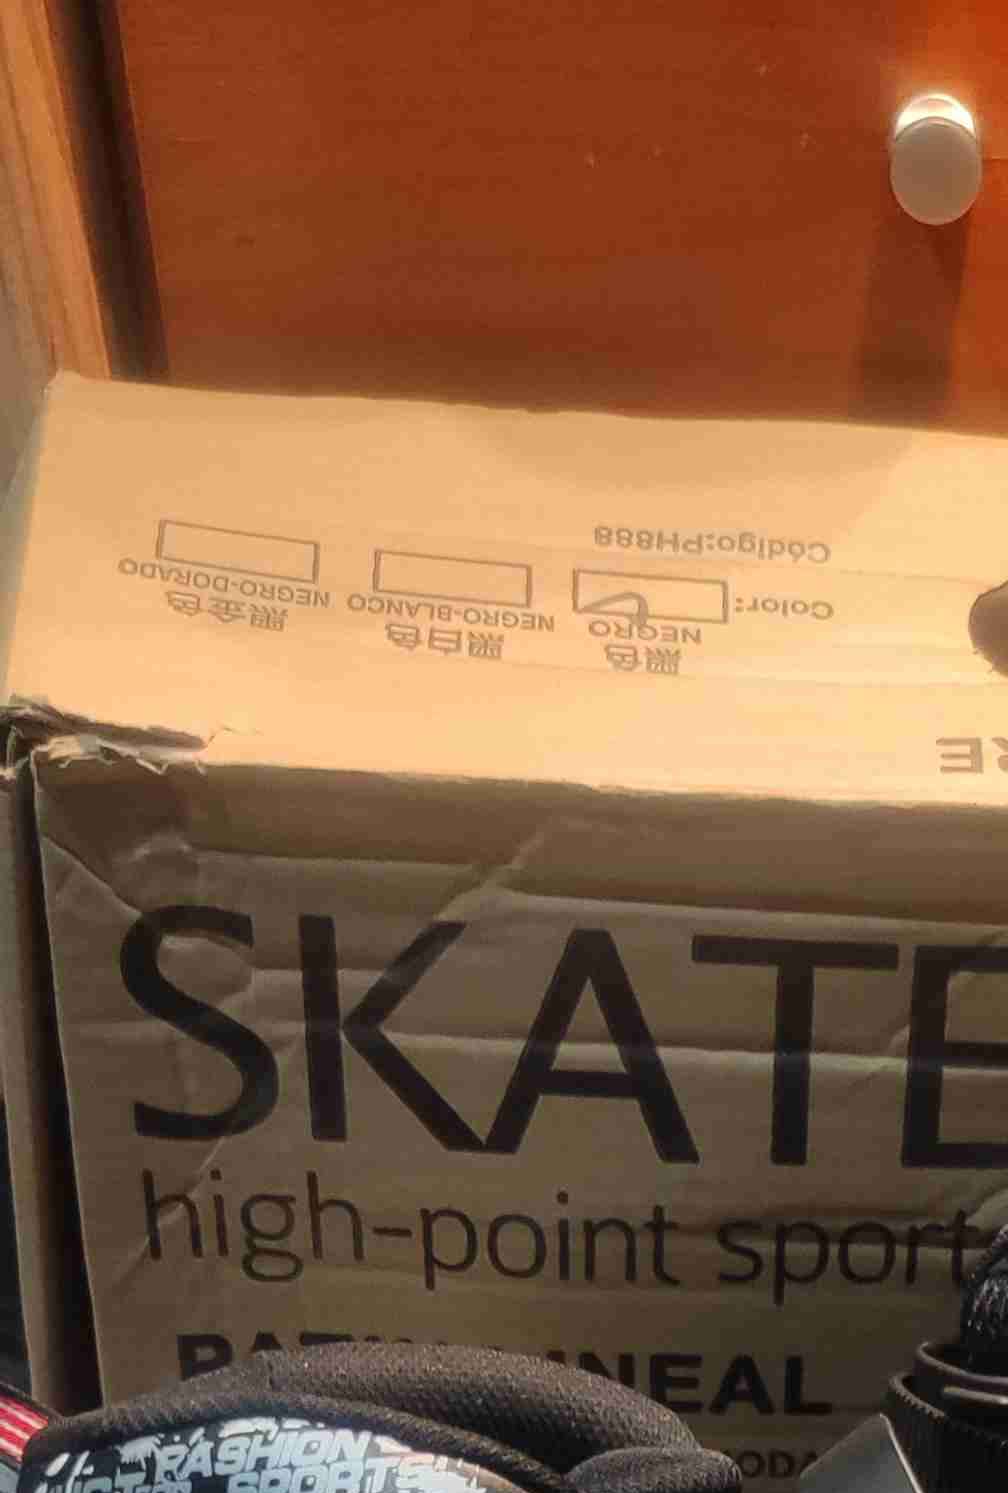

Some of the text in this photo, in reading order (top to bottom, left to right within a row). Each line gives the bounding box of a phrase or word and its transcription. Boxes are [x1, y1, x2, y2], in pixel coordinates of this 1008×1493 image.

[594, 525, 832, 565] Código:PH888
[117, 557, 330, 608] NEGRO-DORADO
[346, 593, 555, 631] NEGRO-BLANCO
[734, 596, 835, 622] Color:
[588, 618, 703, 645] NEGRO
[141, 1169, 680, 1290] high-point
